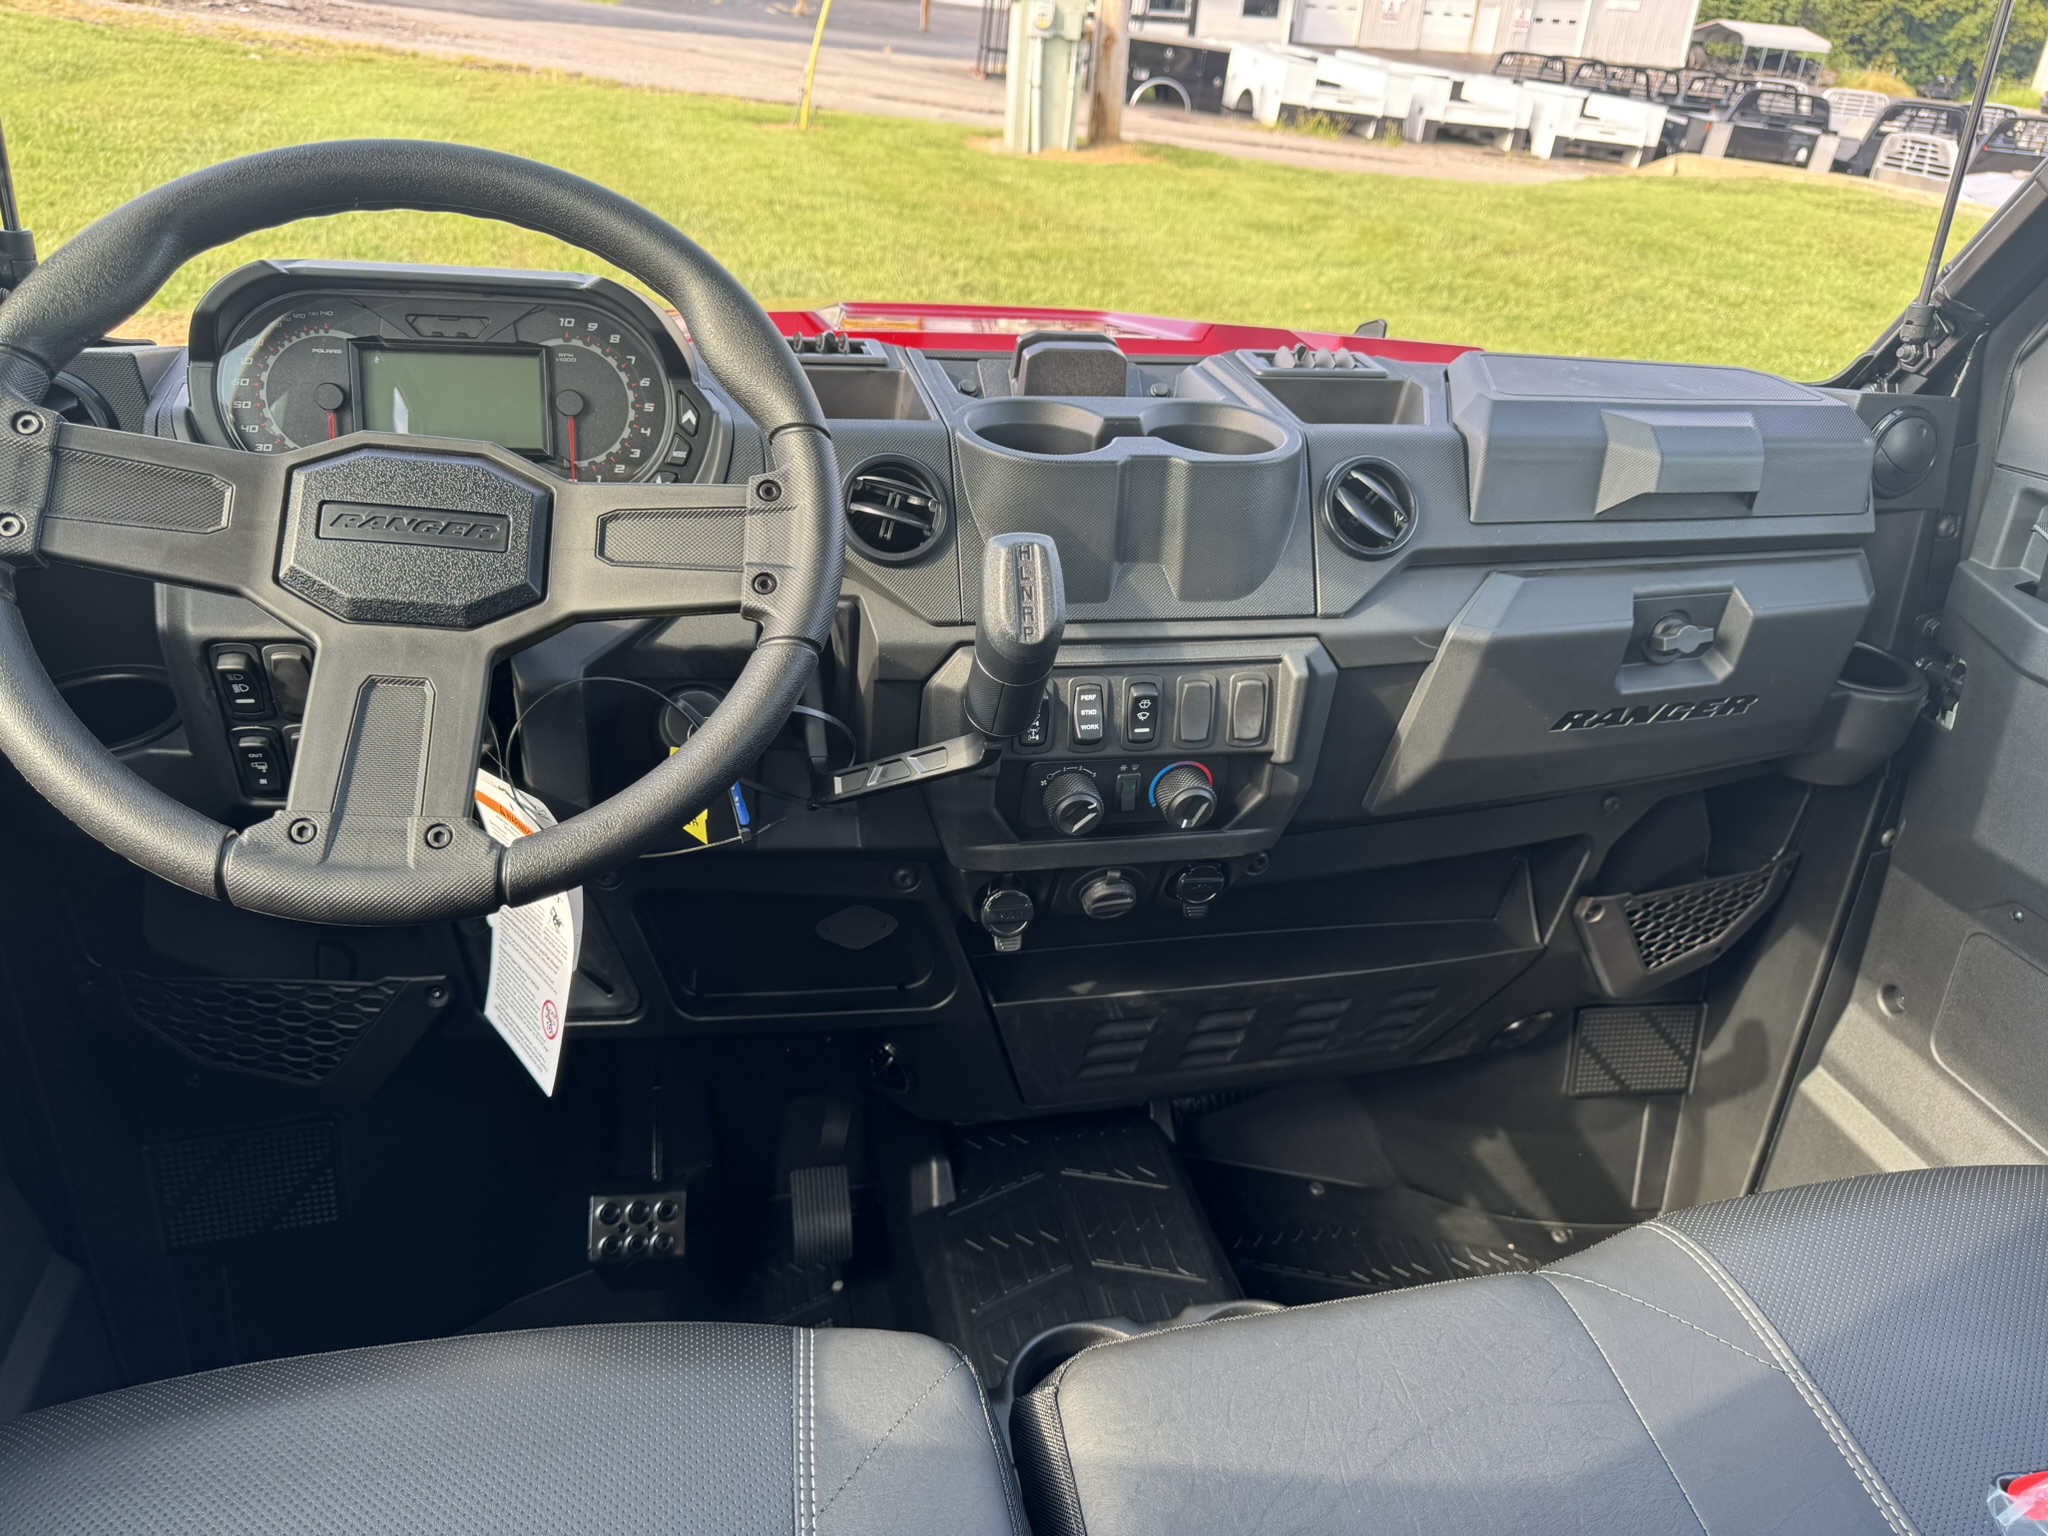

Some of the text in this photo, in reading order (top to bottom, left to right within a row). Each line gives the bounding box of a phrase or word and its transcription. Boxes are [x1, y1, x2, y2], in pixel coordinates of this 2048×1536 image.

[559, 318, 575, 327] 10
[587, 322, 598, 331] 9
[609, 334, 621, 343] 8
[626, 356, 636, 365] 7
[639, 378, 651, 387] 6
[233, 401, 251, 409] 50
[643, 403, 655, 412] 5
[241, 425, 259, 433] 40
[640, 427, 651, 437] 4
[254, 444, 273, 452] 30
[629, 449, 641, 458] 3
[614, 464, 626, 473] 2
[329, 512, 500, 540] RANGER
[1548, 693, 1759, 733] RANGER
